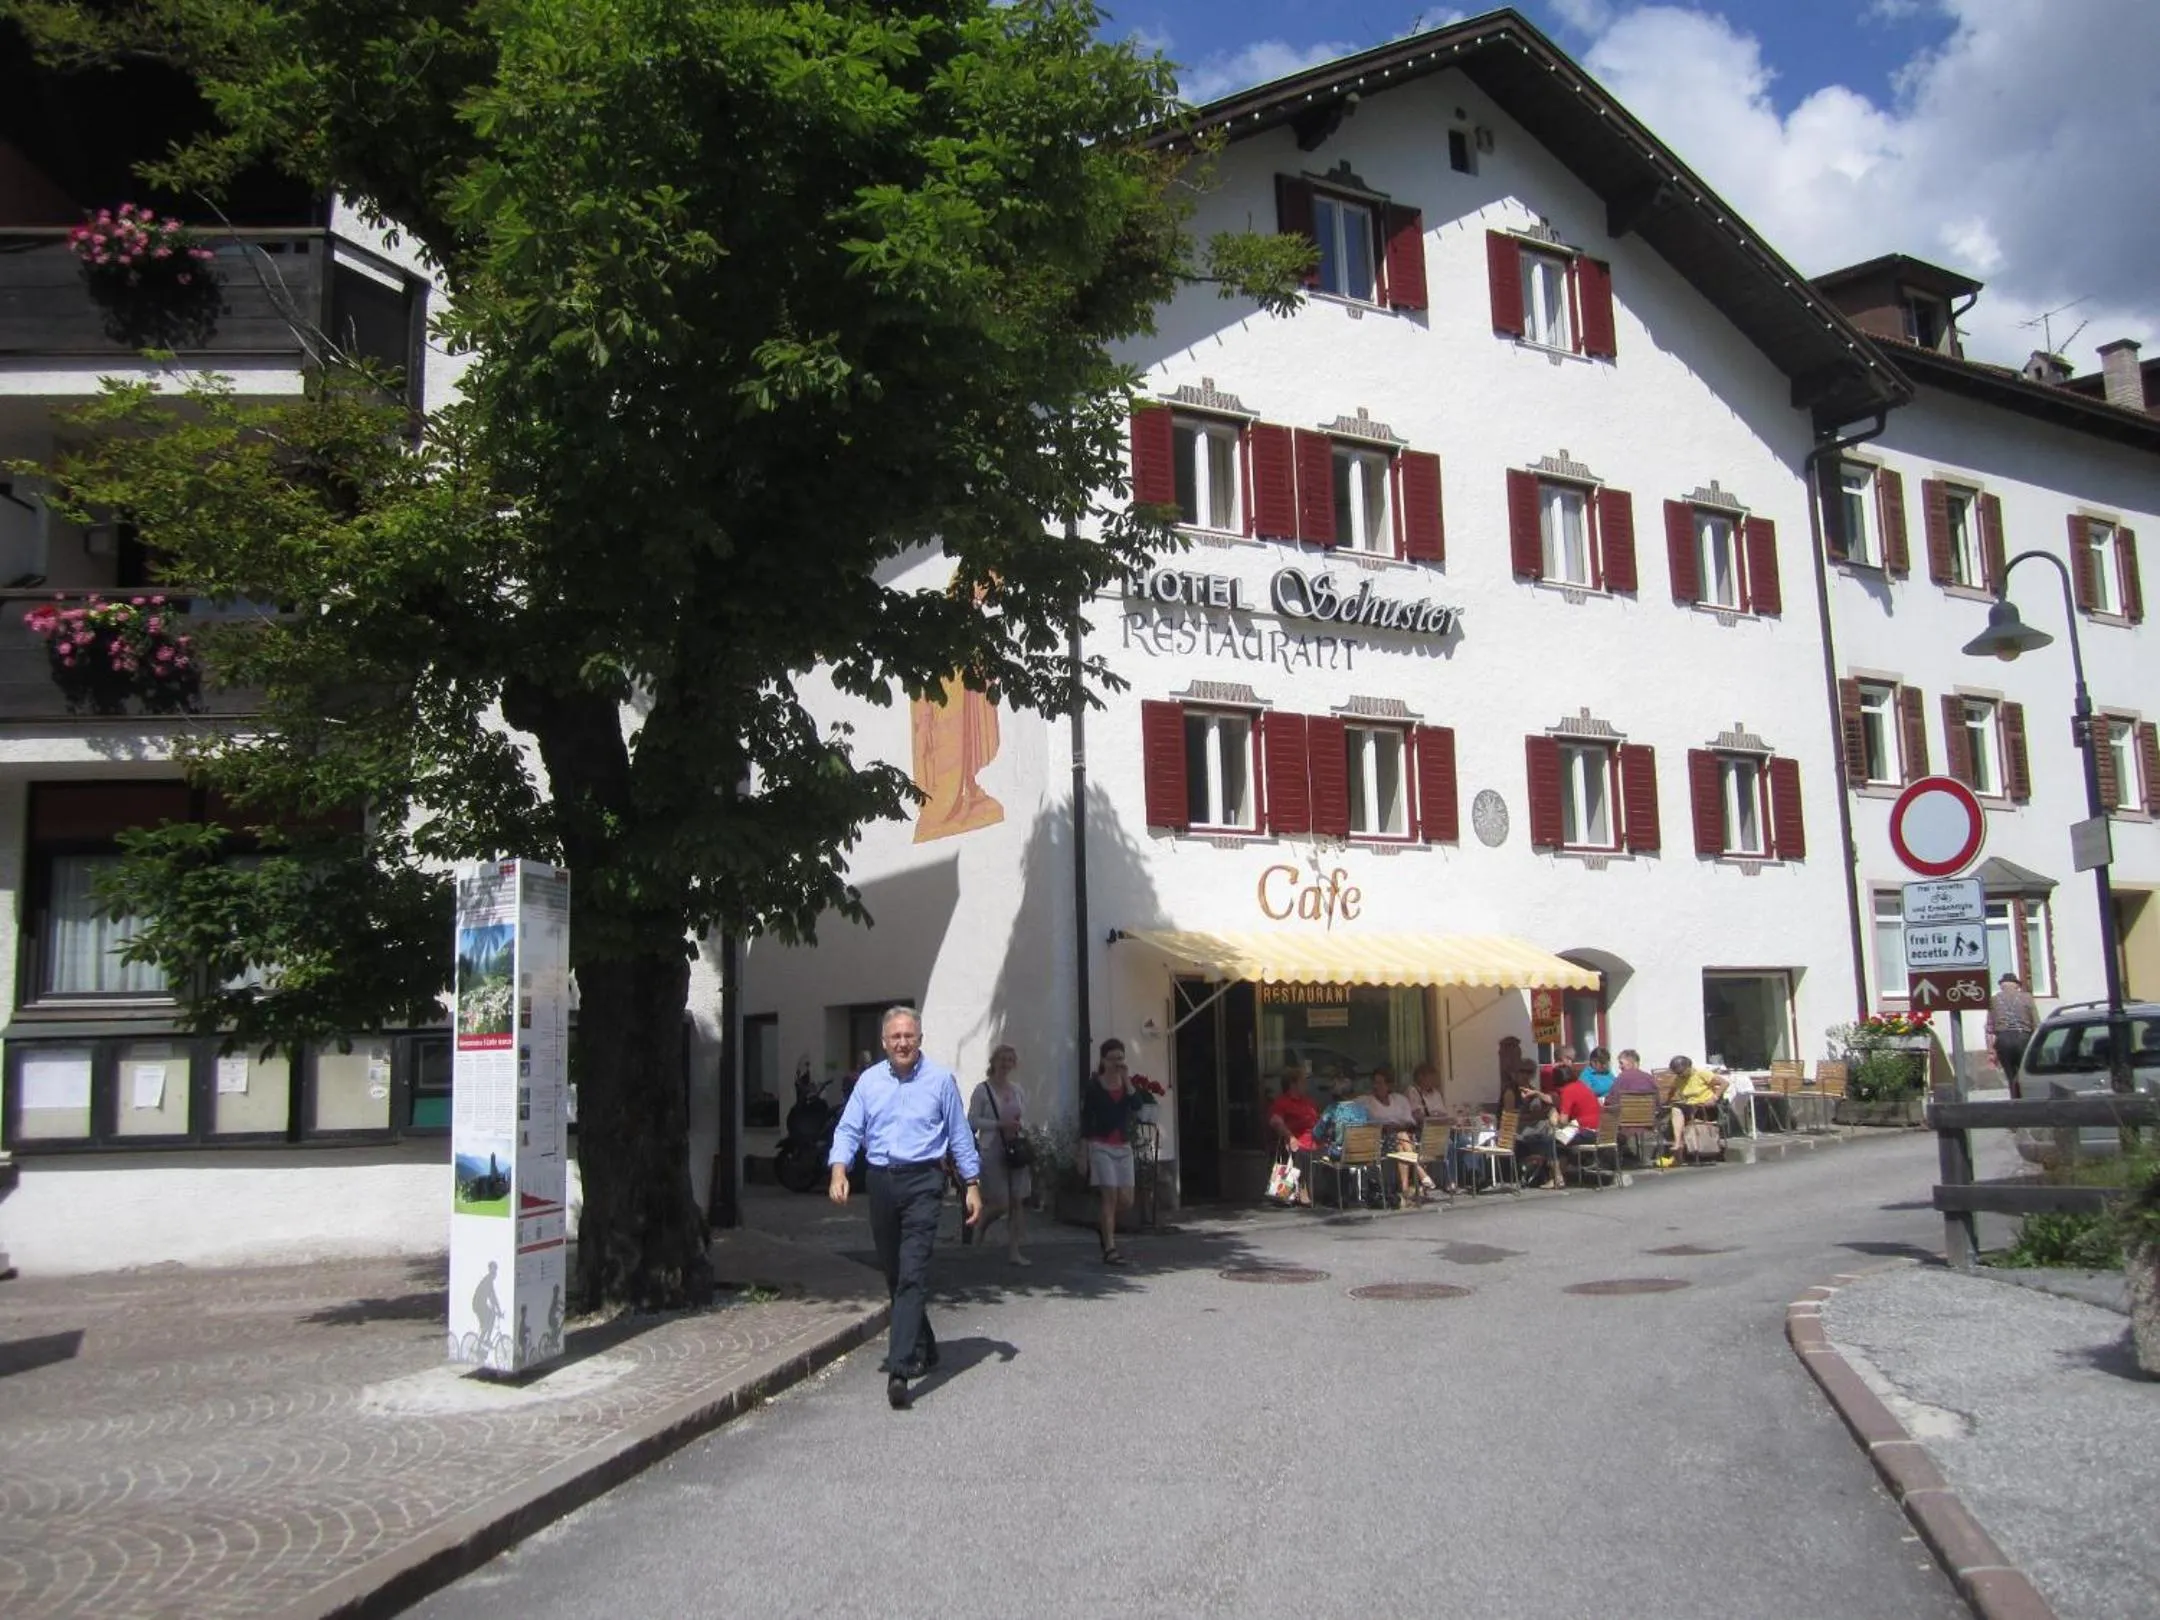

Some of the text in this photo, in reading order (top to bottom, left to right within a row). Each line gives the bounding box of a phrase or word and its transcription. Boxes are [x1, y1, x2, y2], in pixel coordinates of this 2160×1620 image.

[1122, 567, 1466, 636] HOTEL Schuster
[1119, 611, 1358, 675] RESTAURANT
[1257, 864, 1361, 931] Cafe
[1910, 934, 1929, 945] frei
[1263, 986, 1353, 1003] RESTAURANT
